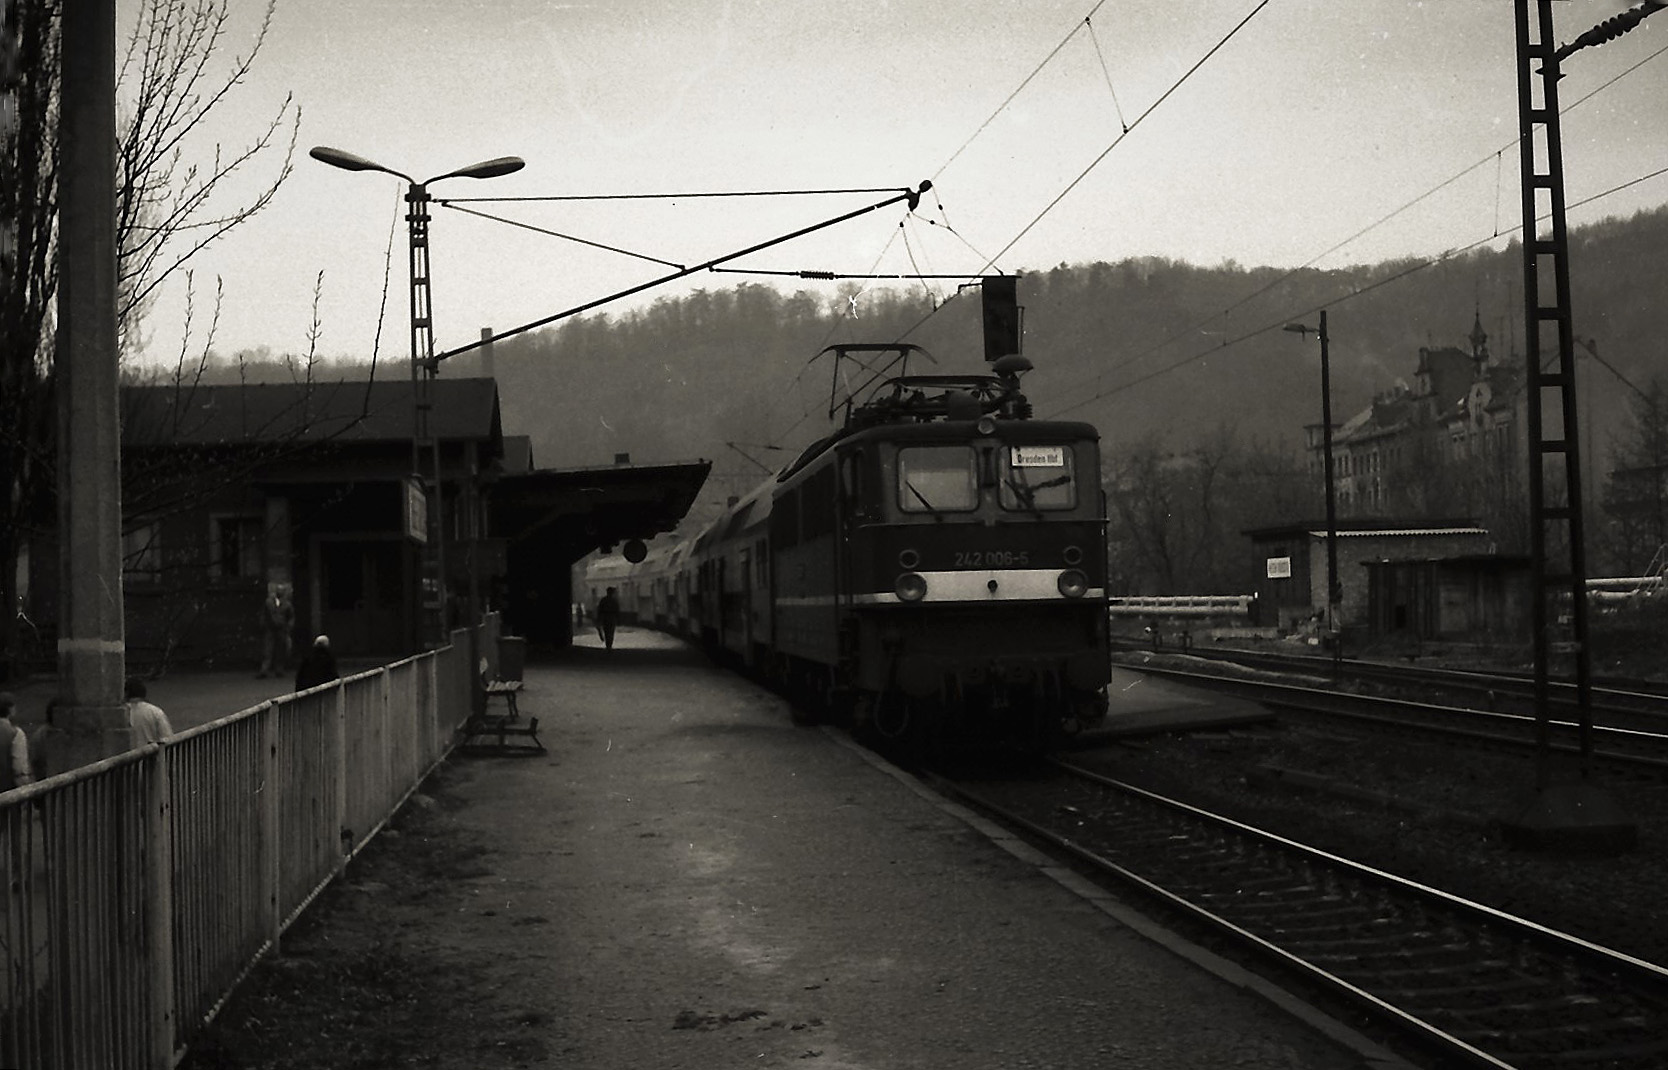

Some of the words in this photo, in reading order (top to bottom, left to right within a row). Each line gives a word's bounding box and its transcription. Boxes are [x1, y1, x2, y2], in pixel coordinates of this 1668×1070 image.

[1017, 454, 1046, 463] Dresden
[955, 552, 982, 567] 242
[985, 551, 1029, 566] 006-5
